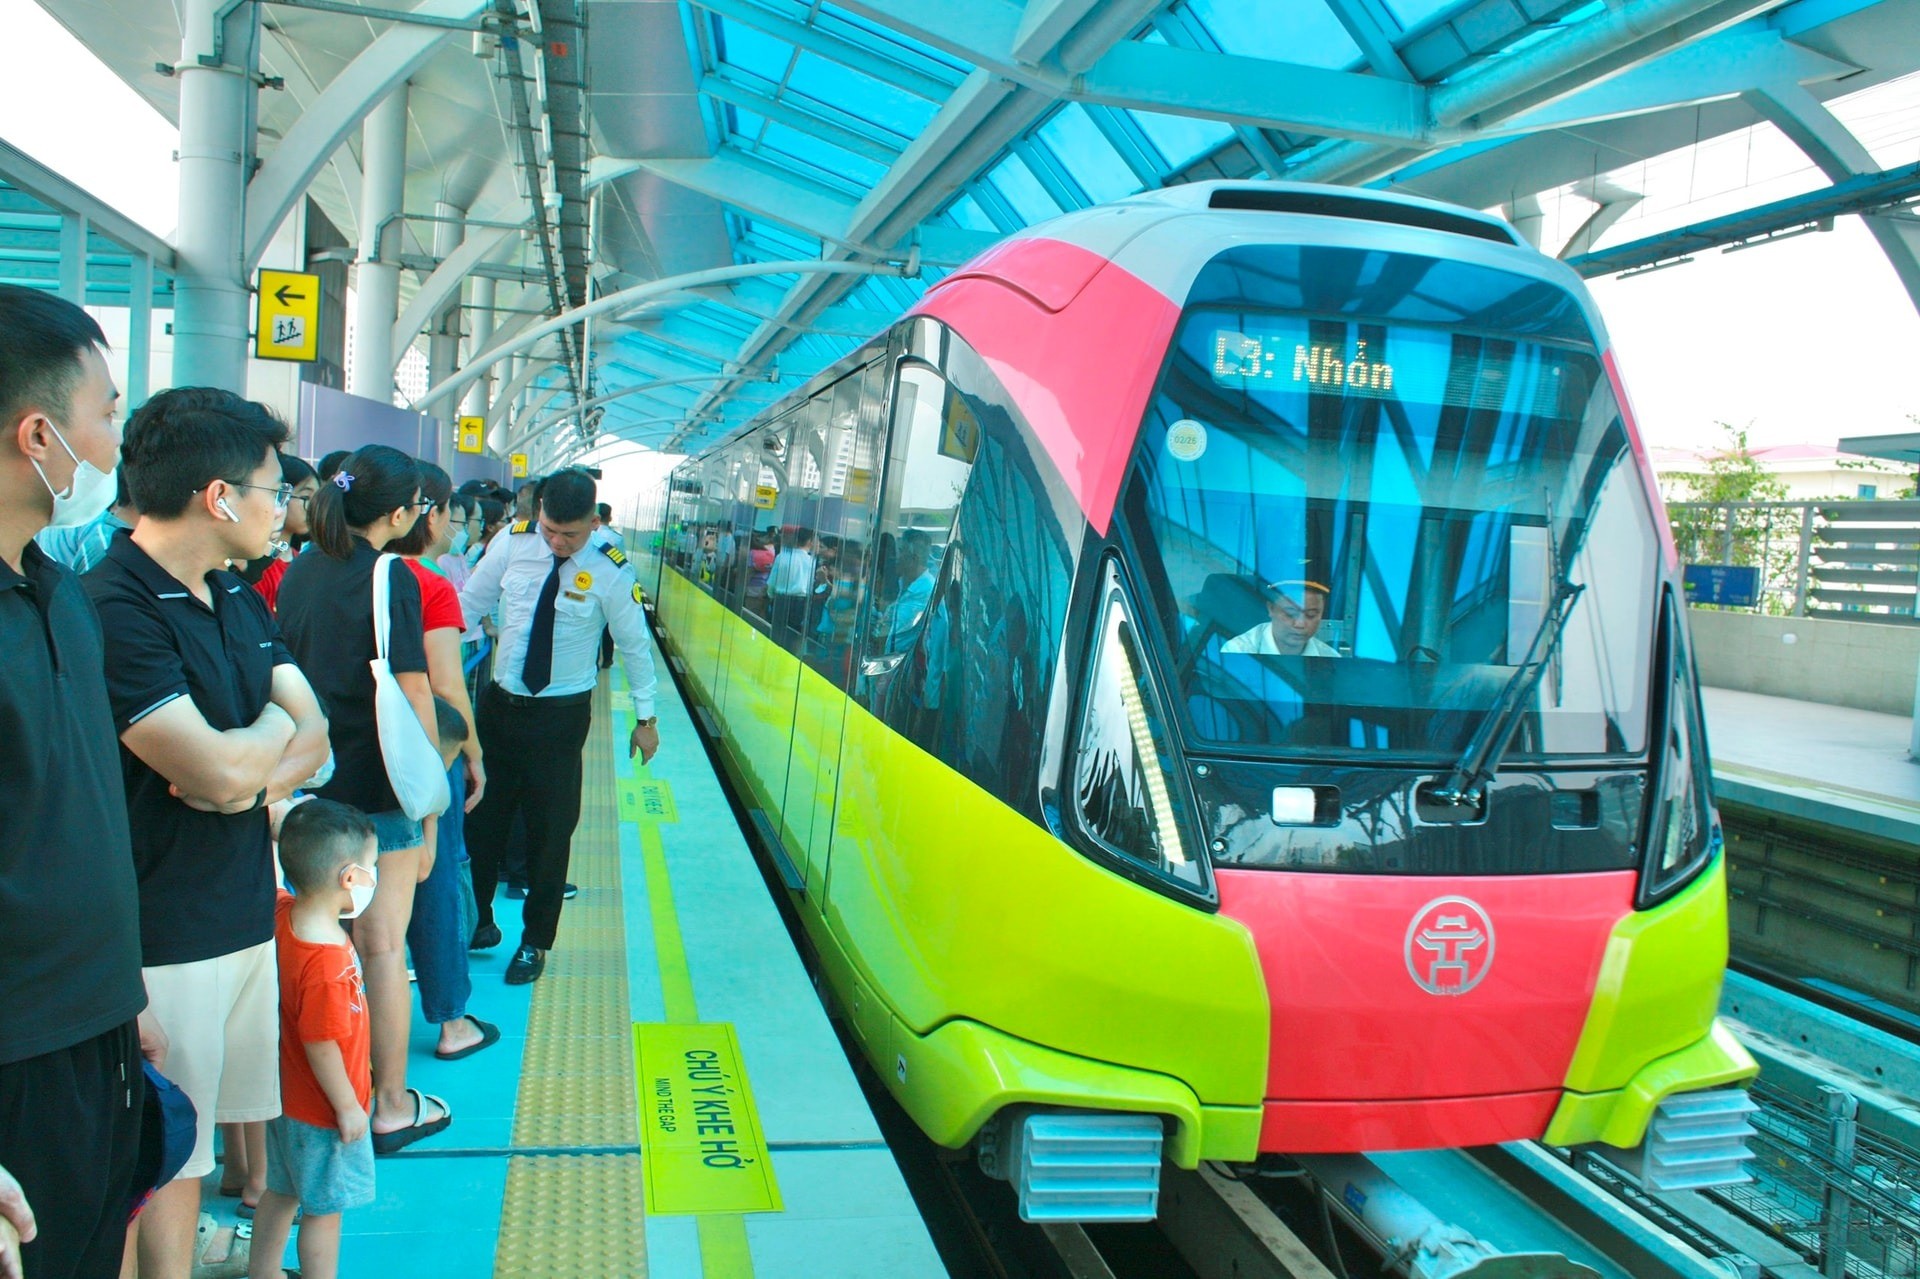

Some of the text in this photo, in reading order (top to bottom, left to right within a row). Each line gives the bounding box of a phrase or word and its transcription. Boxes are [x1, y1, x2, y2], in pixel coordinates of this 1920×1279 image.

[1215, 337, 1393, 390] L3: Nhổn
[655, 1078, 676, 1132] MIND THE GAP
[684, 1050, 754, 1169] CHÚ Ý KHE HỞ
